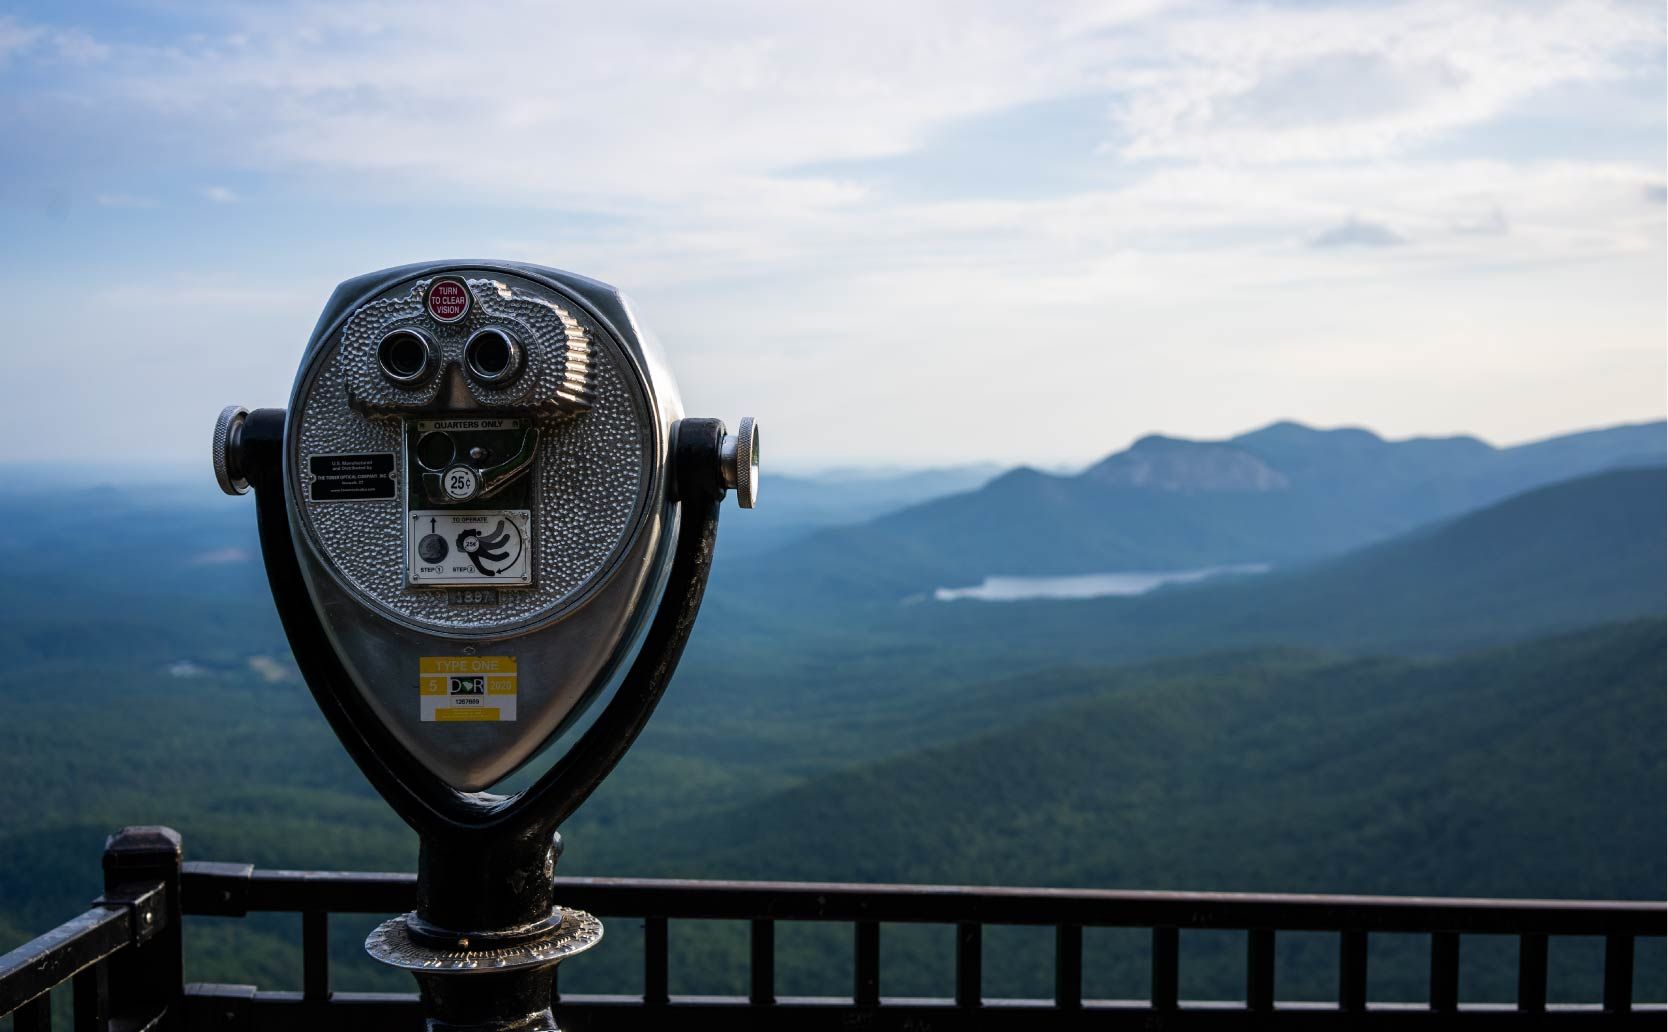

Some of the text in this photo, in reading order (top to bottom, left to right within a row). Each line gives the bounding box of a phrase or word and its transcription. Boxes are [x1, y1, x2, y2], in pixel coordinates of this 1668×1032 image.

[434, 421, 479, 429] QUARTERS
[437, 660, 499, 671] TYPE ONE
[429, 680, 438, 692] 5
[490, 680, 512, 690] 2020
